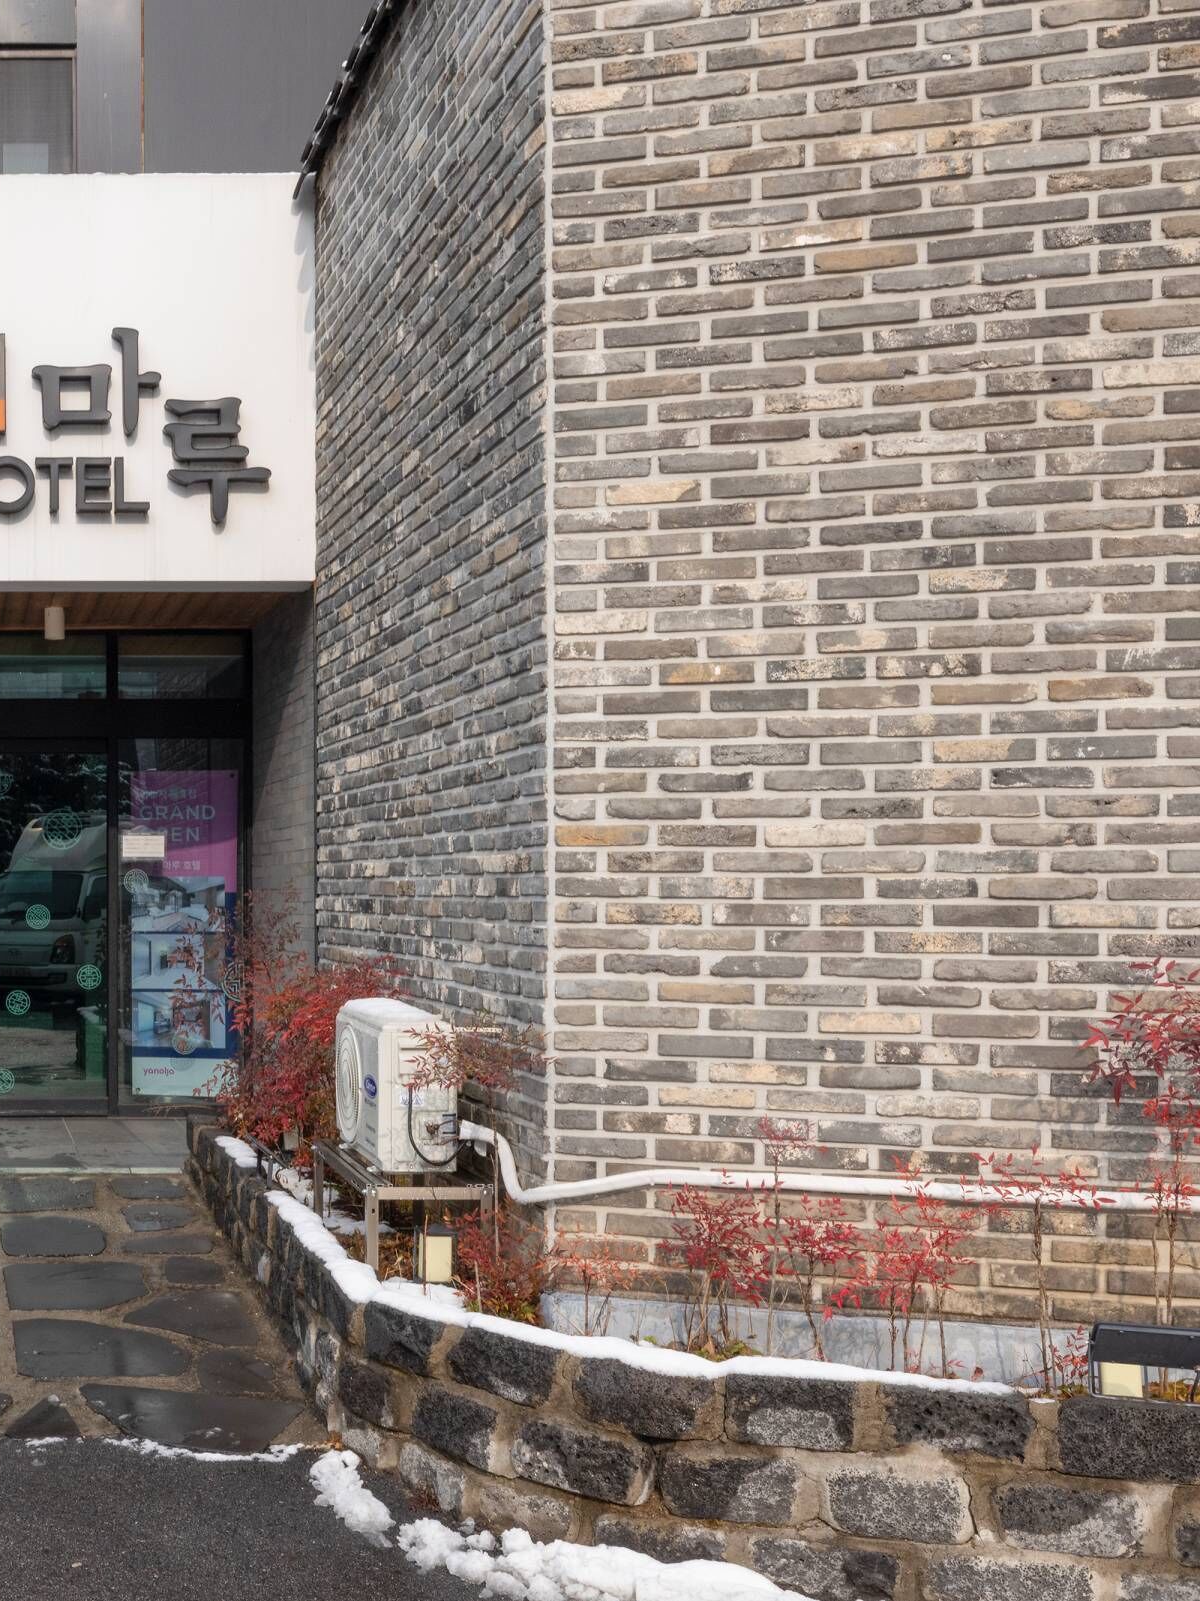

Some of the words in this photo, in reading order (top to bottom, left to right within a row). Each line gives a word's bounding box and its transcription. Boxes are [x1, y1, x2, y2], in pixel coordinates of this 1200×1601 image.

[31, 327, 271, 526] 마루
[139, 804, 216, 821] GRAND
[143, 1066, 175, 1076] yanolja
